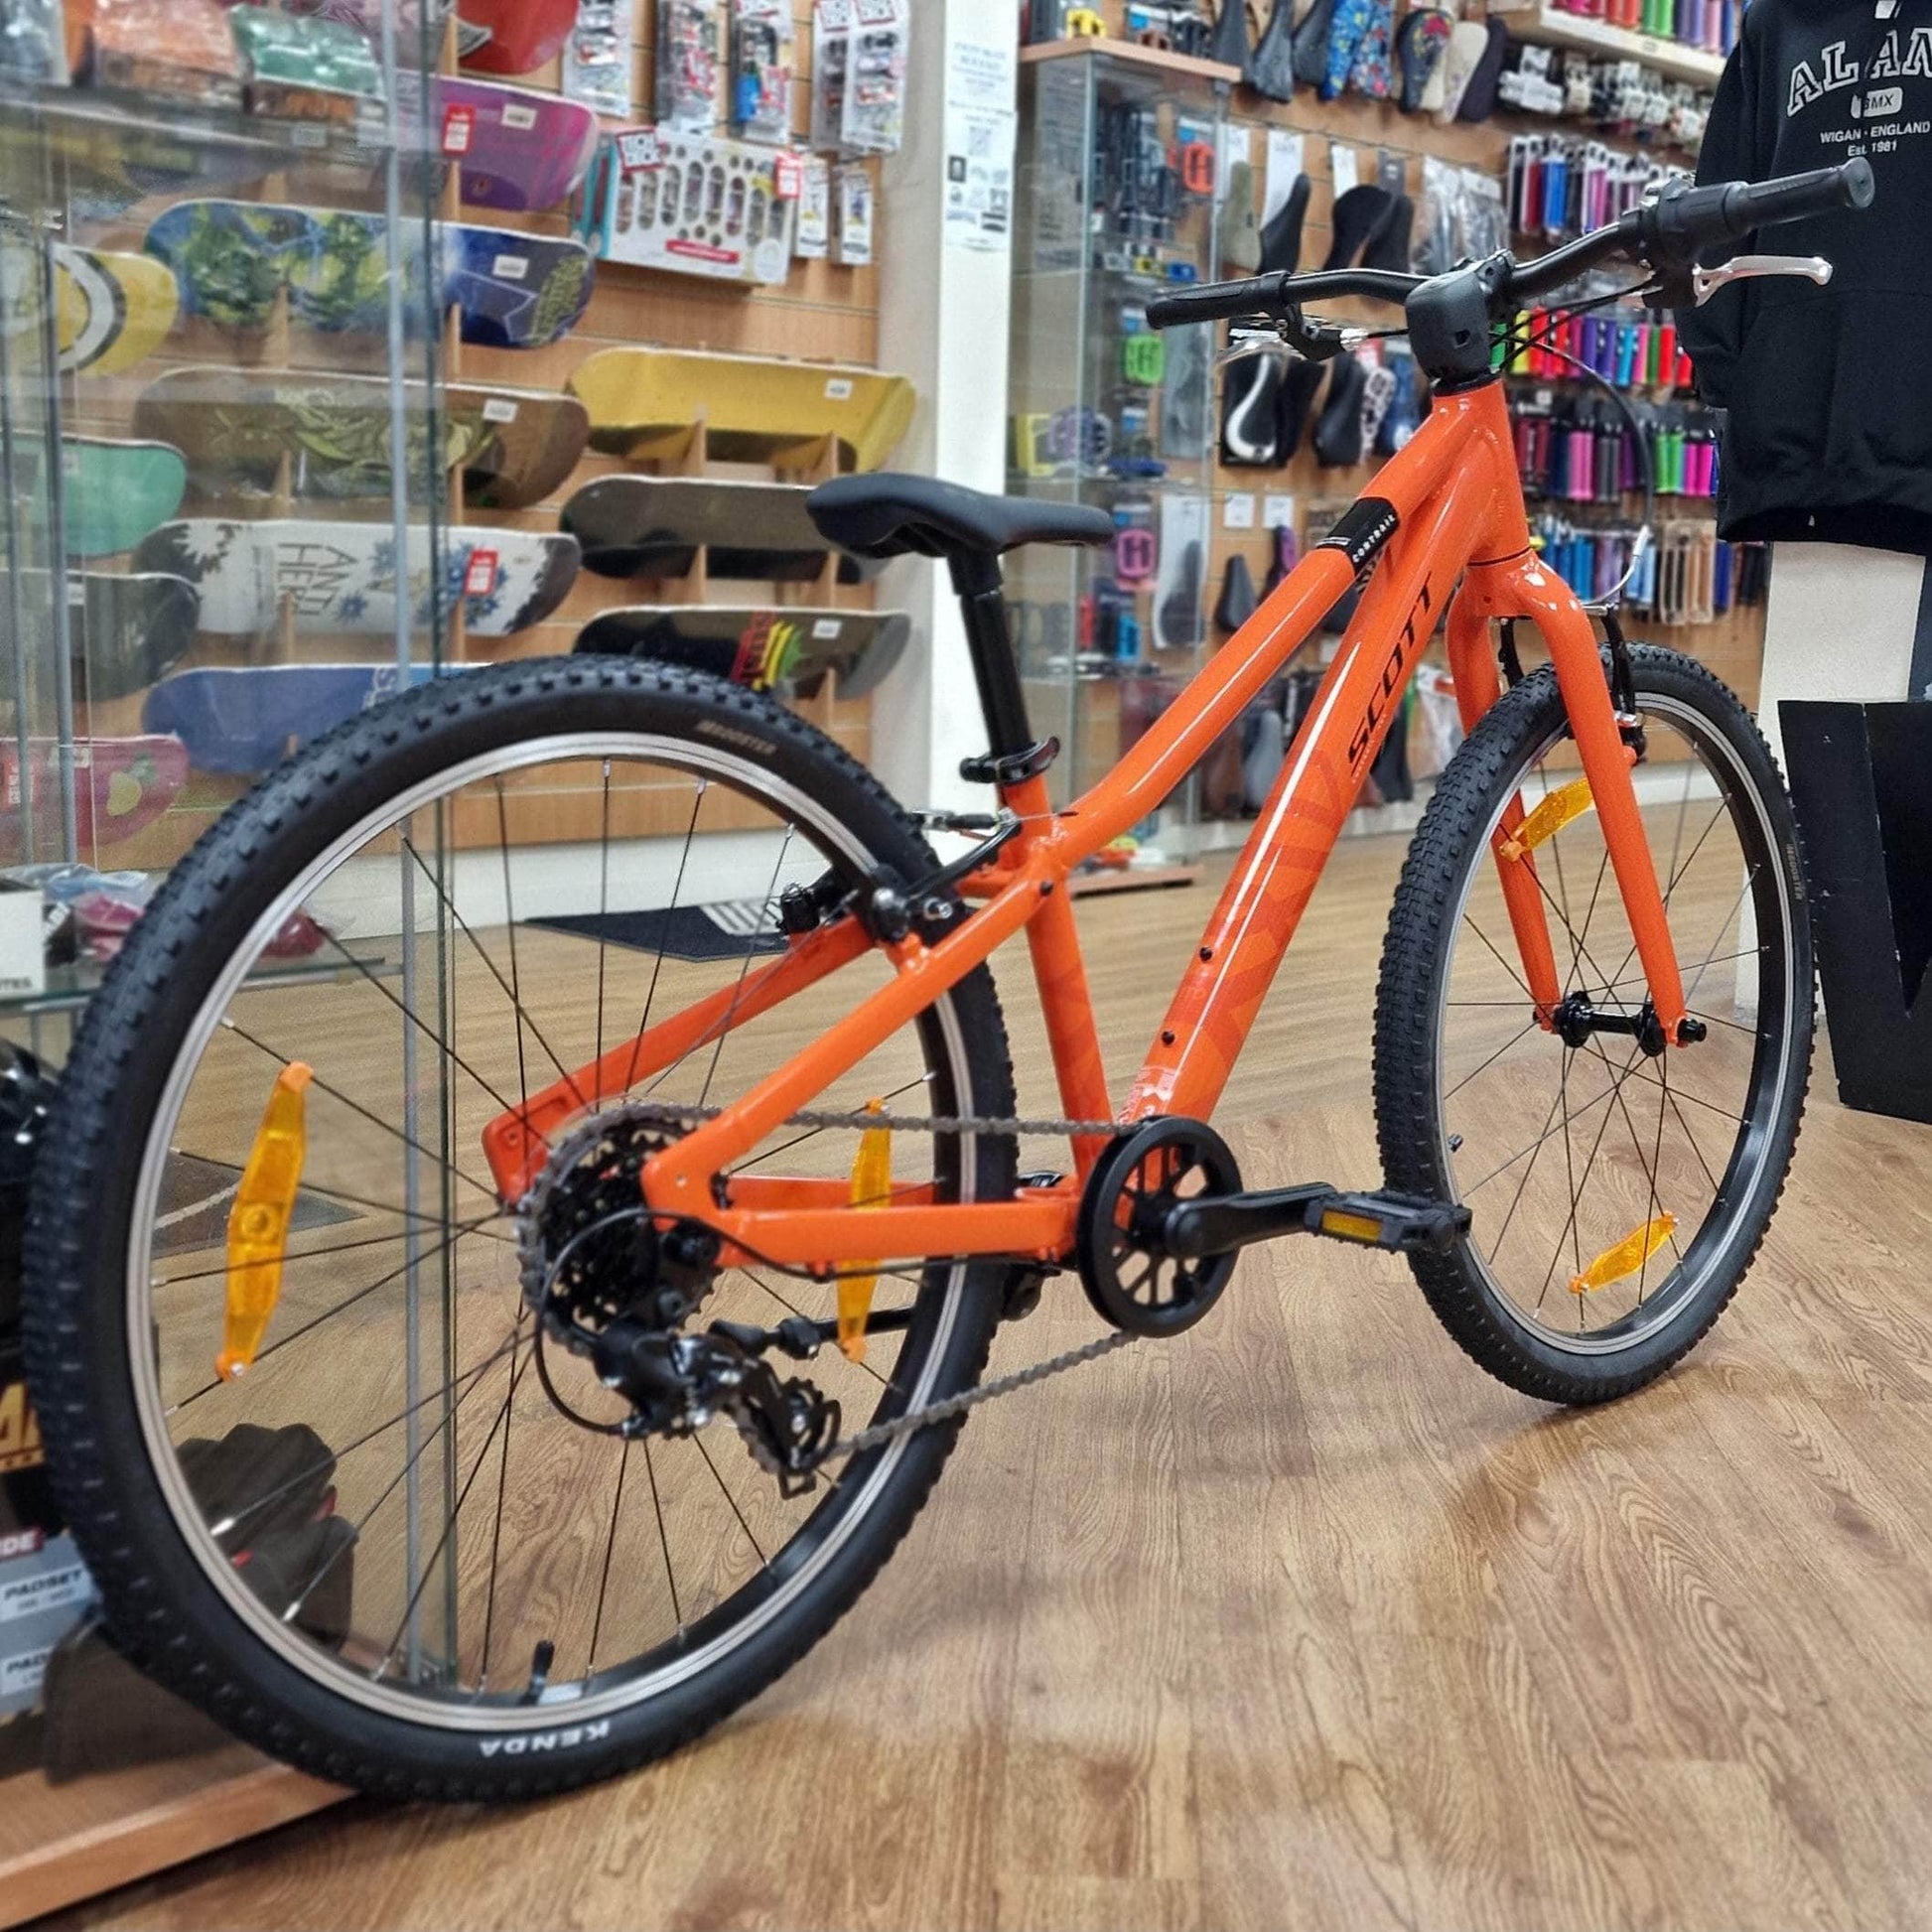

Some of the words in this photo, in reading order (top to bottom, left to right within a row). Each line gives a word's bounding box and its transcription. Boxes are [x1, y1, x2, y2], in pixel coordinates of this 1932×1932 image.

[1820, 128, 1862, 143] WIGAN
[1870, 120, 1931, 138] ENGLAND
[1871, 140, 1897, 153] 1981
[1348, 570, 1433, 776] SCOTT
[480, 1719, 610, 1757] KENDA
